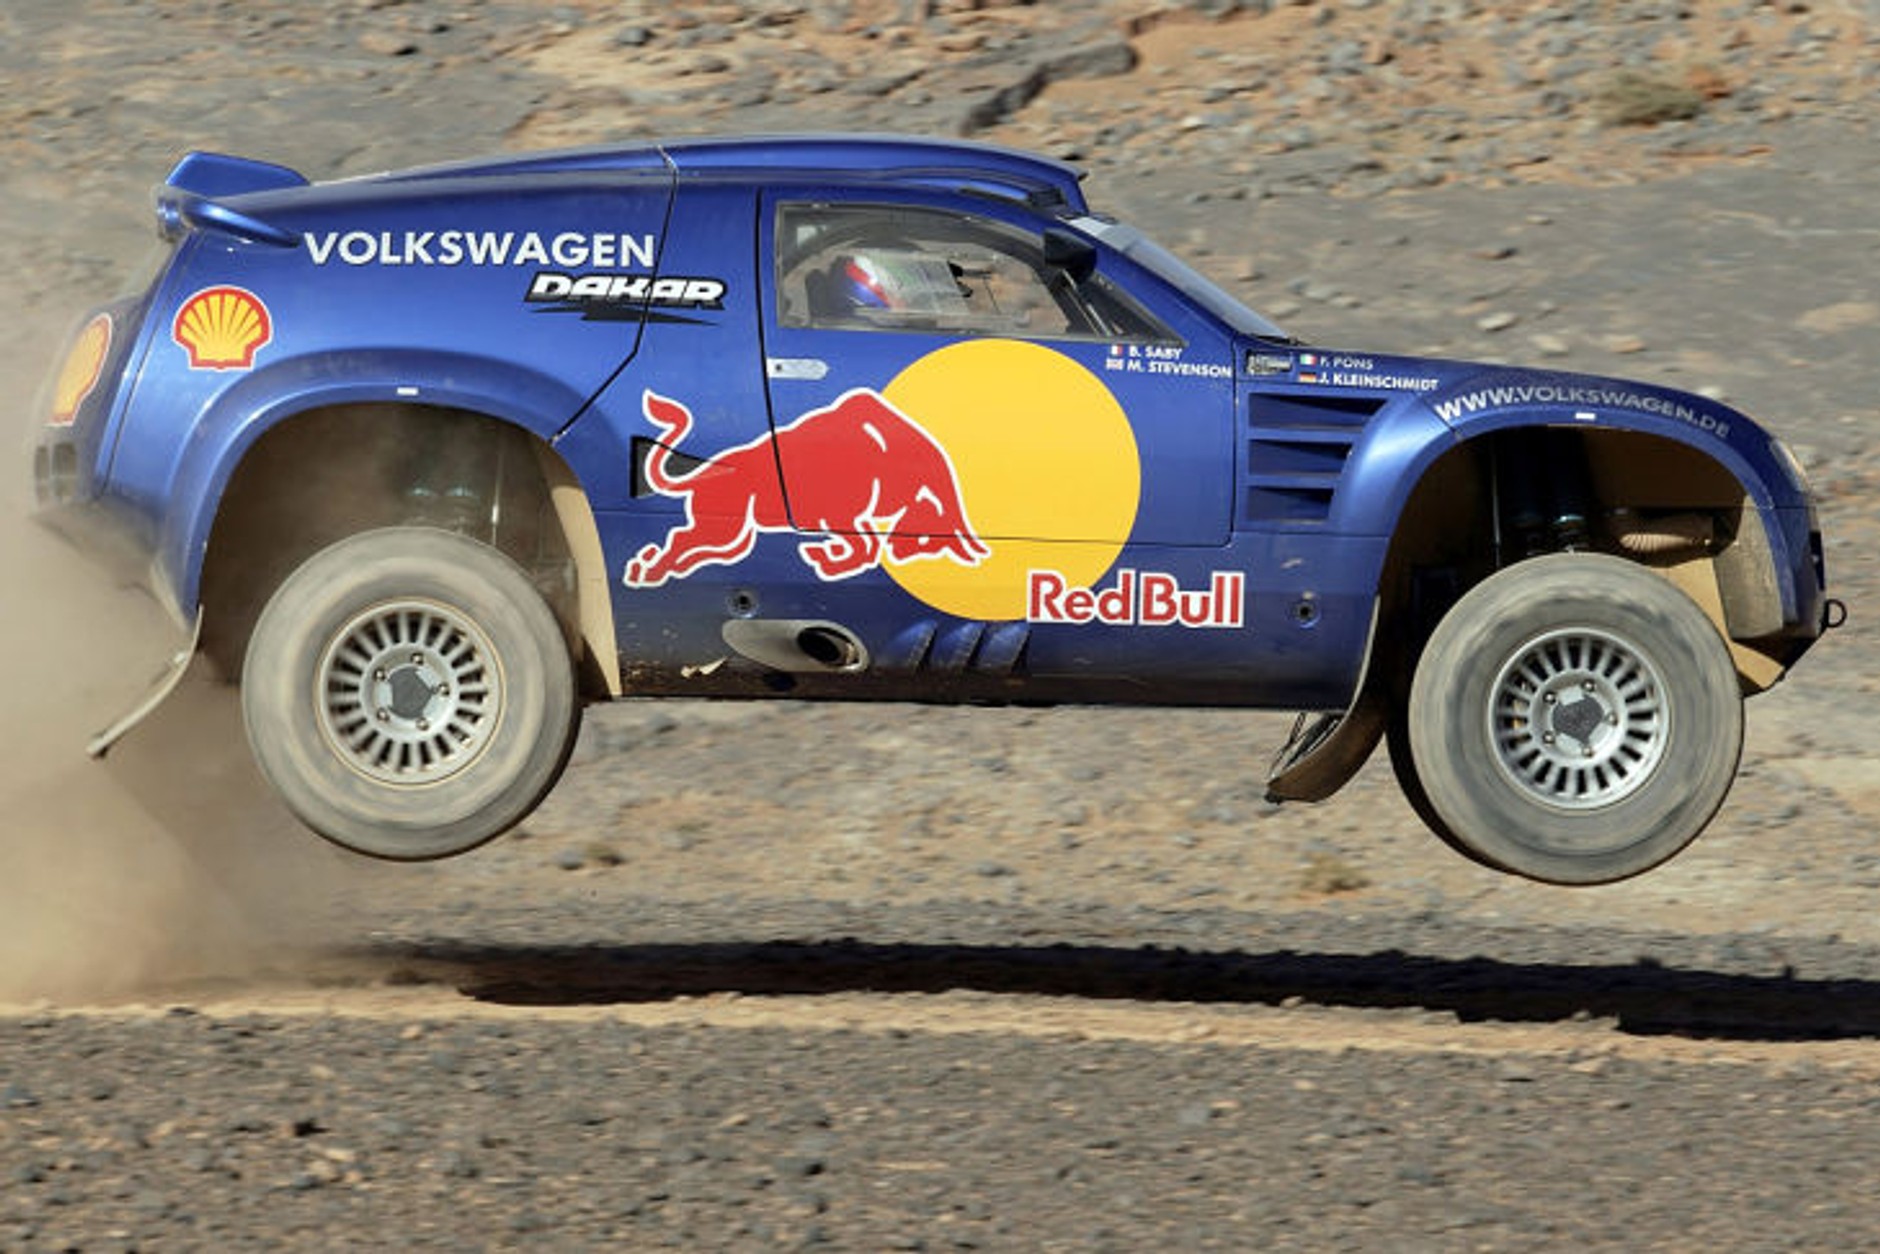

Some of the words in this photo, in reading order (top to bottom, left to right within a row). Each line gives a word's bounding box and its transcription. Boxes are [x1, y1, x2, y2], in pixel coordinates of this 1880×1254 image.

[304, 231, 656, 268] VOLKSWAGEN
[527, 272, 727, 310] DAKAR
[1129, 345, 1142, 358] B.
[1145, 345, 1183, 360] SABY
[1333, 357, 1374, 370] PONS
[1127, 359, 1145, 373] M.
[1147, 361, 1232, 378] STEVENSON
[1332, 373, 1440, 391] KLEINSCHMIDT
[1435, 386, 1731, 437] WWW.VOLKSWAGEN.DE
[1029, 570, 1133, 623] Red
[1140, 573, 1243, 626] Bull
